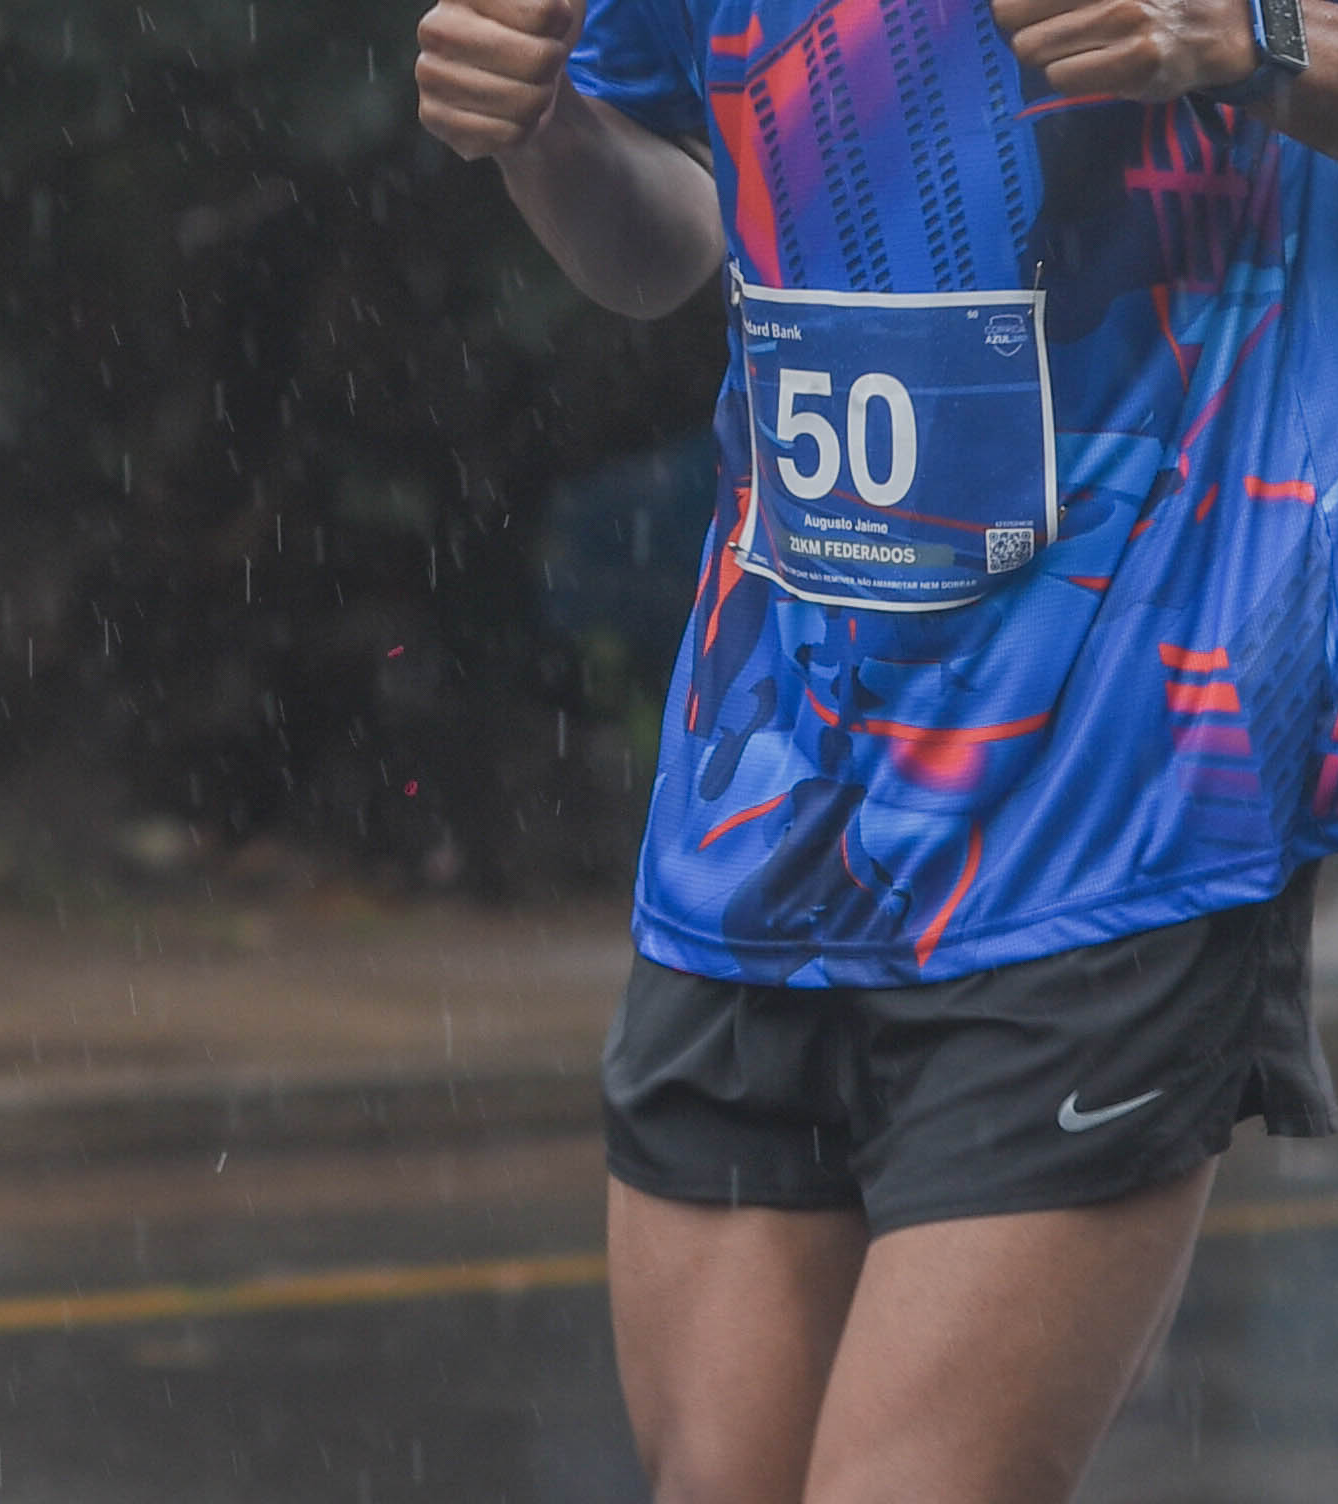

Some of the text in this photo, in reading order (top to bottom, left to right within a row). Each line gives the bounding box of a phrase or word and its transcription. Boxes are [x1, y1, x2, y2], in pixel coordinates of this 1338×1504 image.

[772, 322, 803, 341] Bank
[776, 367, 918, 507] 50
[804, 512, 853, 532] Augusto
[789, 535, 917, 565] 21KM FEDERADOS
